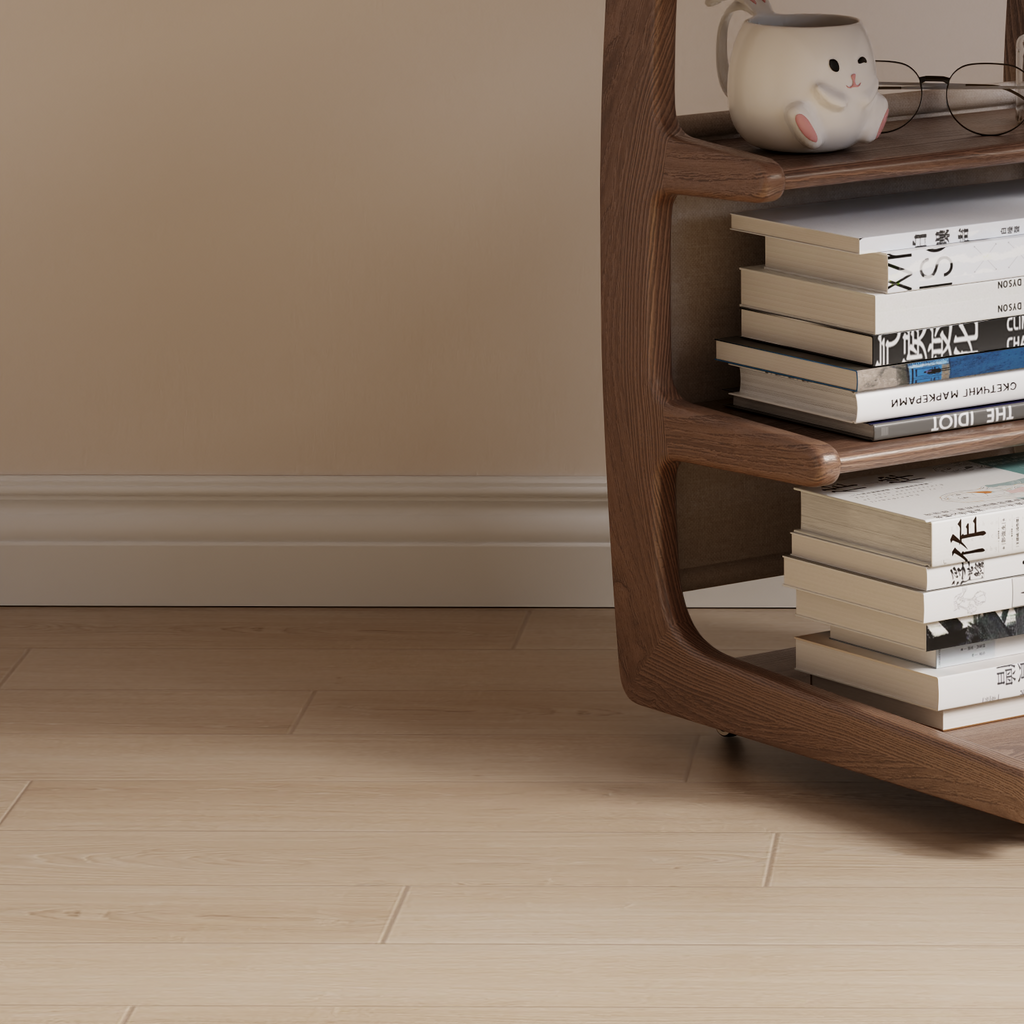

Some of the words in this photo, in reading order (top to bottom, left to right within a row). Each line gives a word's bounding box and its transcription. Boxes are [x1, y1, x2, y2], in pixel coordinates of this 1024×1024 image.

[997, 278, 1022, 289] DYSON
[997, 302, 1022, 313] DYSON
[963, 381, 1017, 397] СКЕТЧИНГ
[891, 390, 958, 408] МАРКЕРАМИ
[930, 410, 975, 432] IDIOT
[986, 405, 1014, 423] THE
